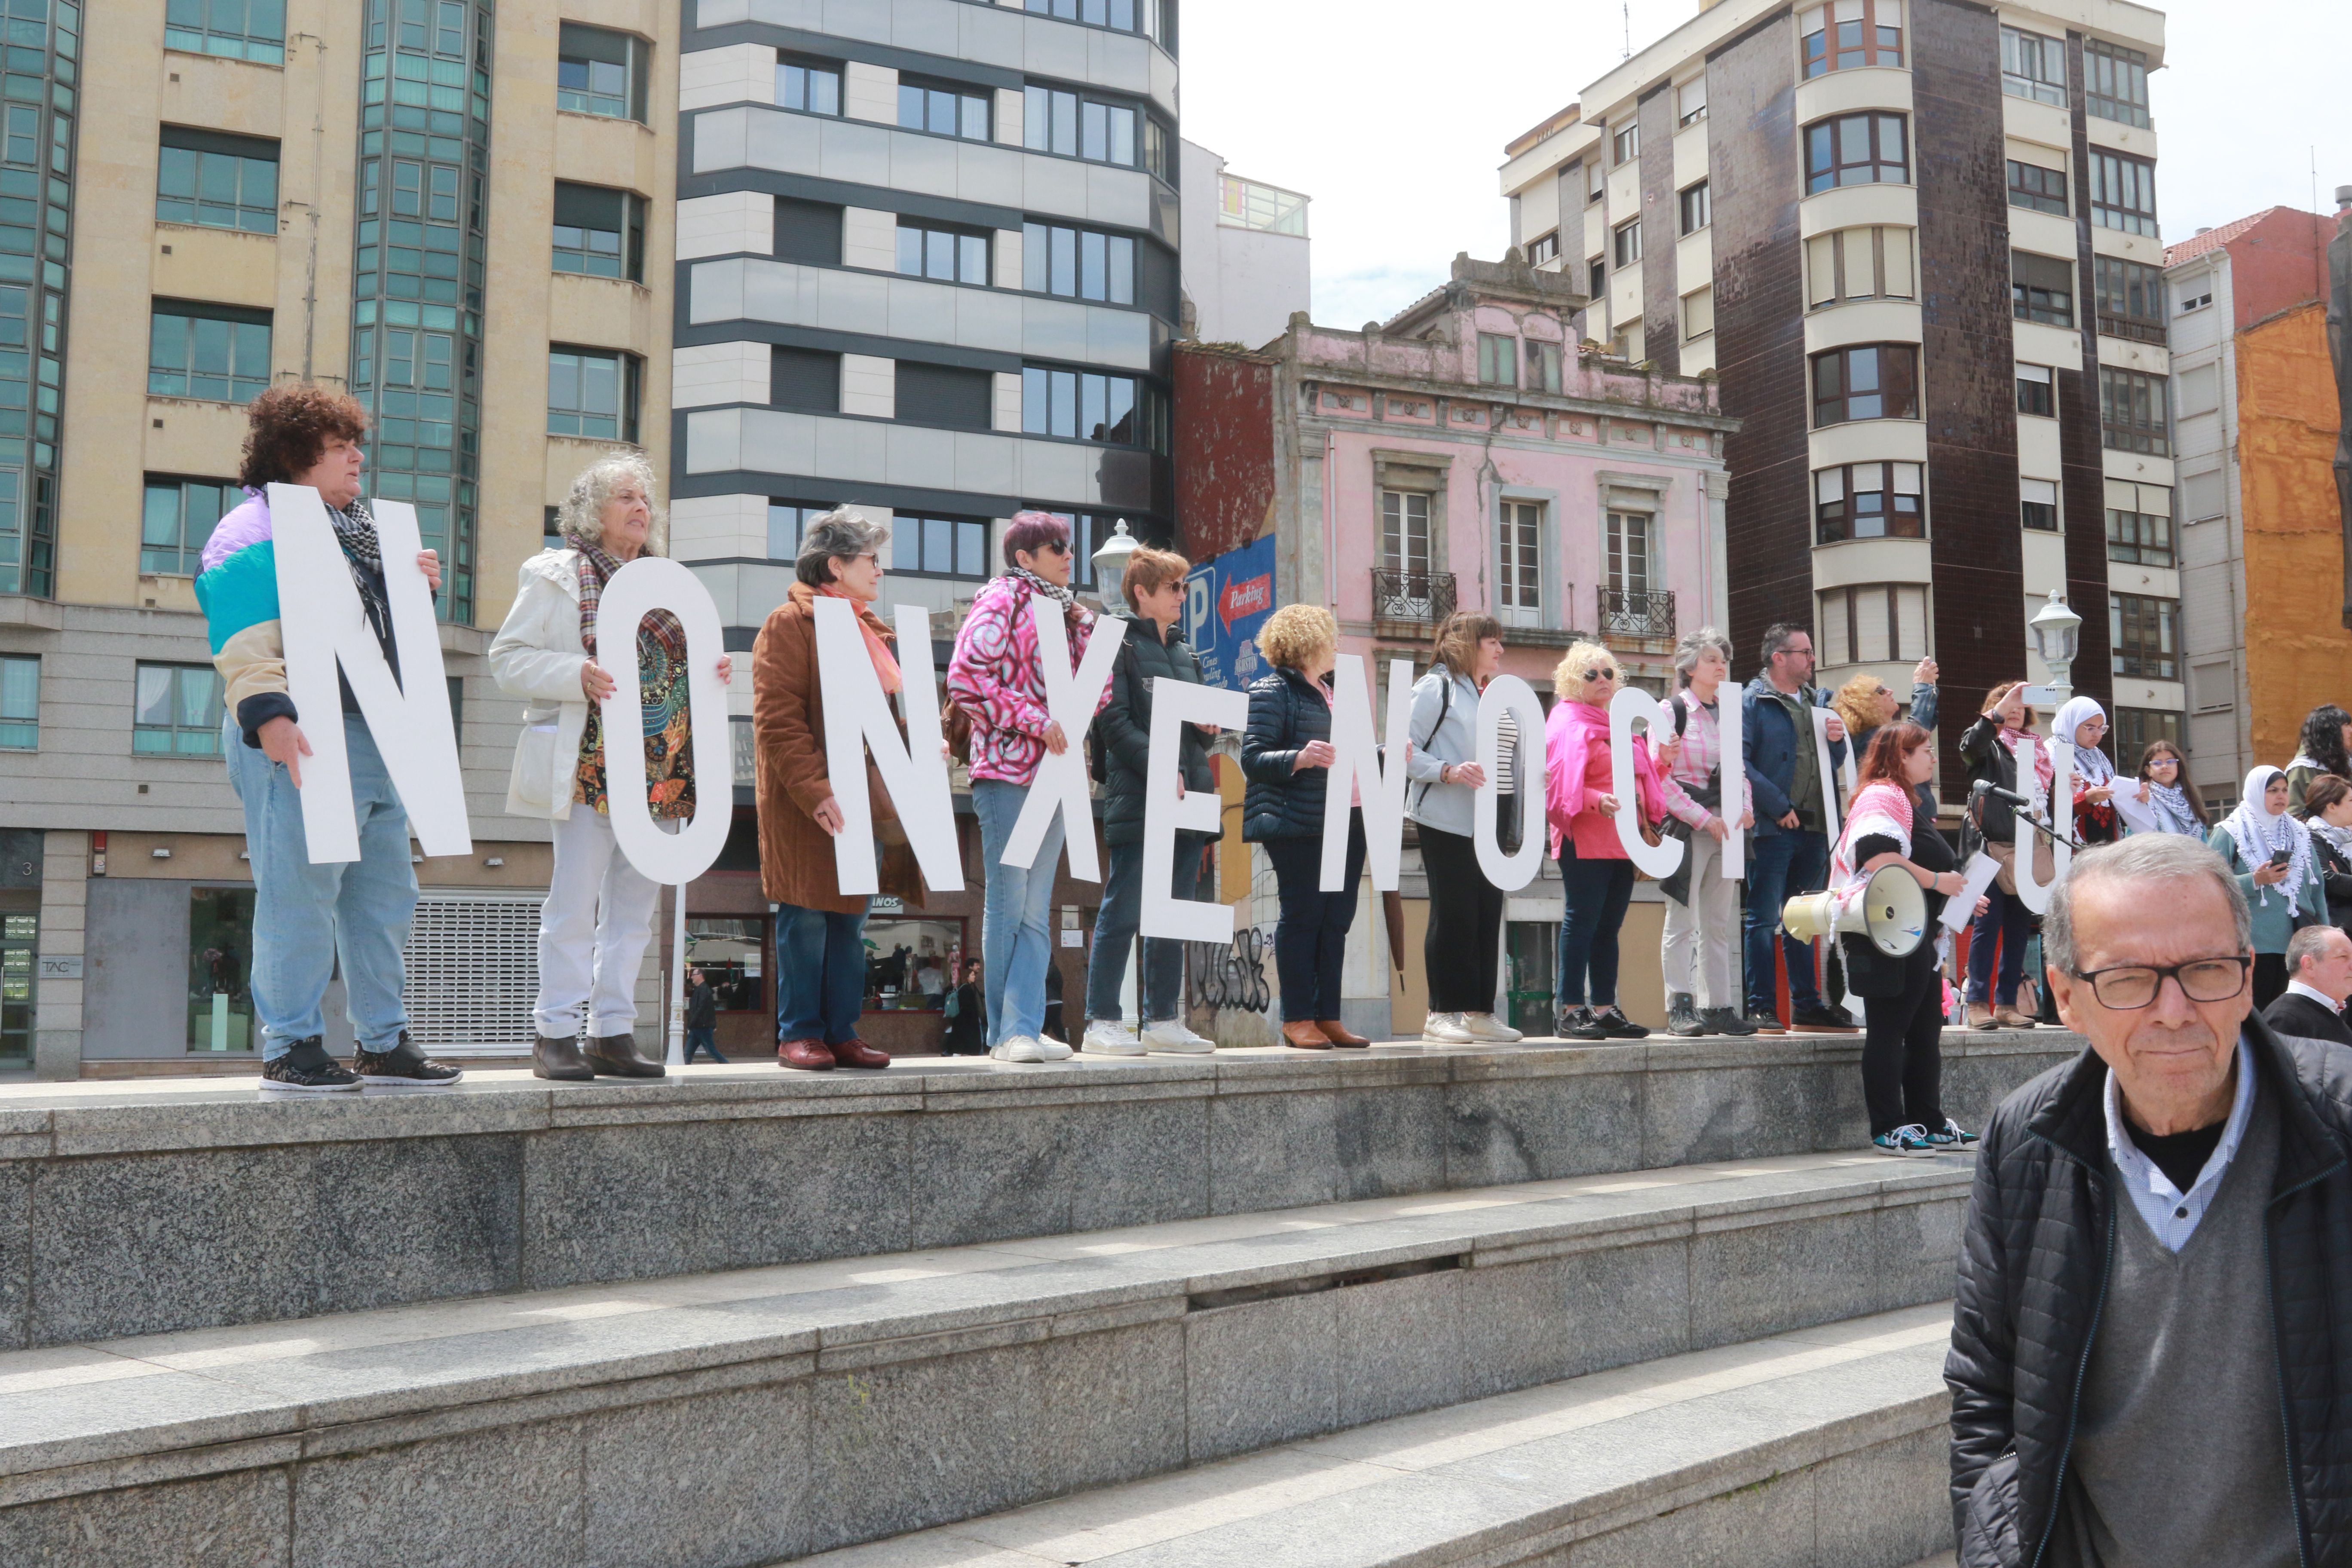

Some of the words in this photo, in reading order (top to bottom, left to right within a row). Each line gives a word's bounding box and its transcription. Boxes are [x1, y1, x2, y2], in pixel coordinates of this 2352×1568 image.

[1230, 585, 1264, 609] Parking
[1190, 577, 1208, 651] P
[1203, 656, 1218, 668] Cines
[1204, 667, 1222, 681] wling
[23, 862, 32, 876] 3
[42, 962, 68, 972] TAC
